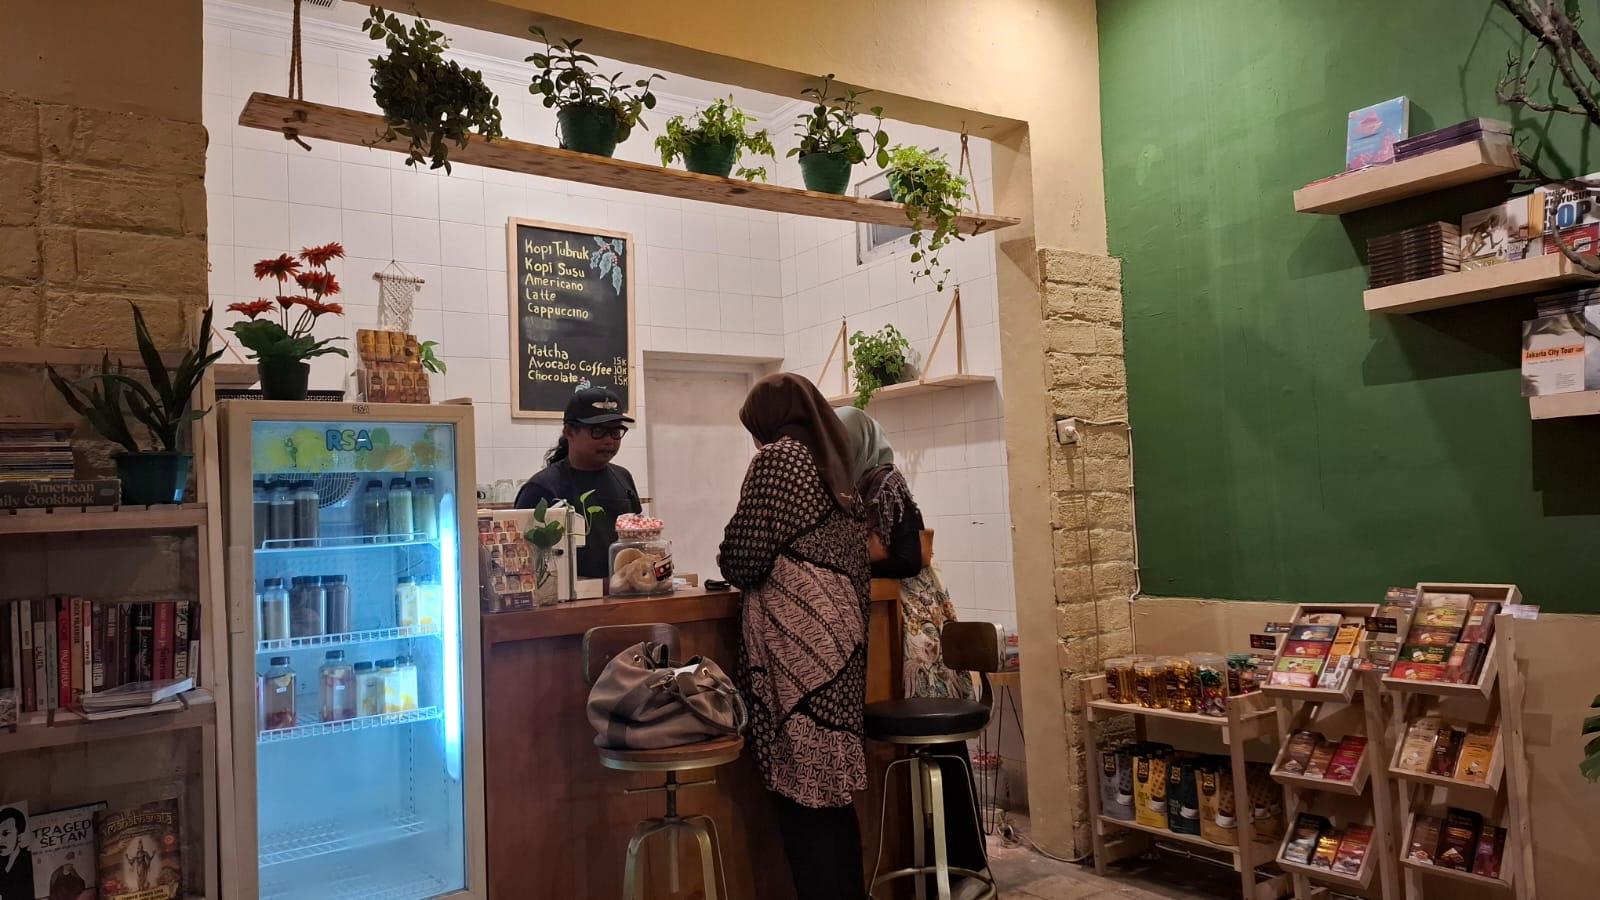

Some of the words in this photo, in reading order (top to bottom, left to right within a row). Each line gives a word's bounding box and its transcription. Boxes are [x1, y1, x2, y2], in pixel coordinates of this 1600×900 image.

[524, 239, 552, 260] Kopi
[552, 241, 589, 260] Tubruk
[525, 257, 553, 274] Kopi
[558, 263, 585, 278] Susu
[524, 273, 584, 291] Americano
[526, 288, 557, 301] Latte
[527, 302, 589, 319] Cappuccino
[527, 343, 569, 360] Matcha
[1526, 351, 1547, 359] Jakarta
[1548, 349, 1559, 357] City
[528, 356, 576, 371] Avocado
[578, 361, 612, 376] Coffee
[527, 370, 578, 383] Chocolate
[352, 405, 369, 414] RSA
[326, 429, 373, 451] RSA
[28, 482, 95, 493] American
[24, 494, 94, 505] Cookbook
[39, 831, 87, 848] SETAN
